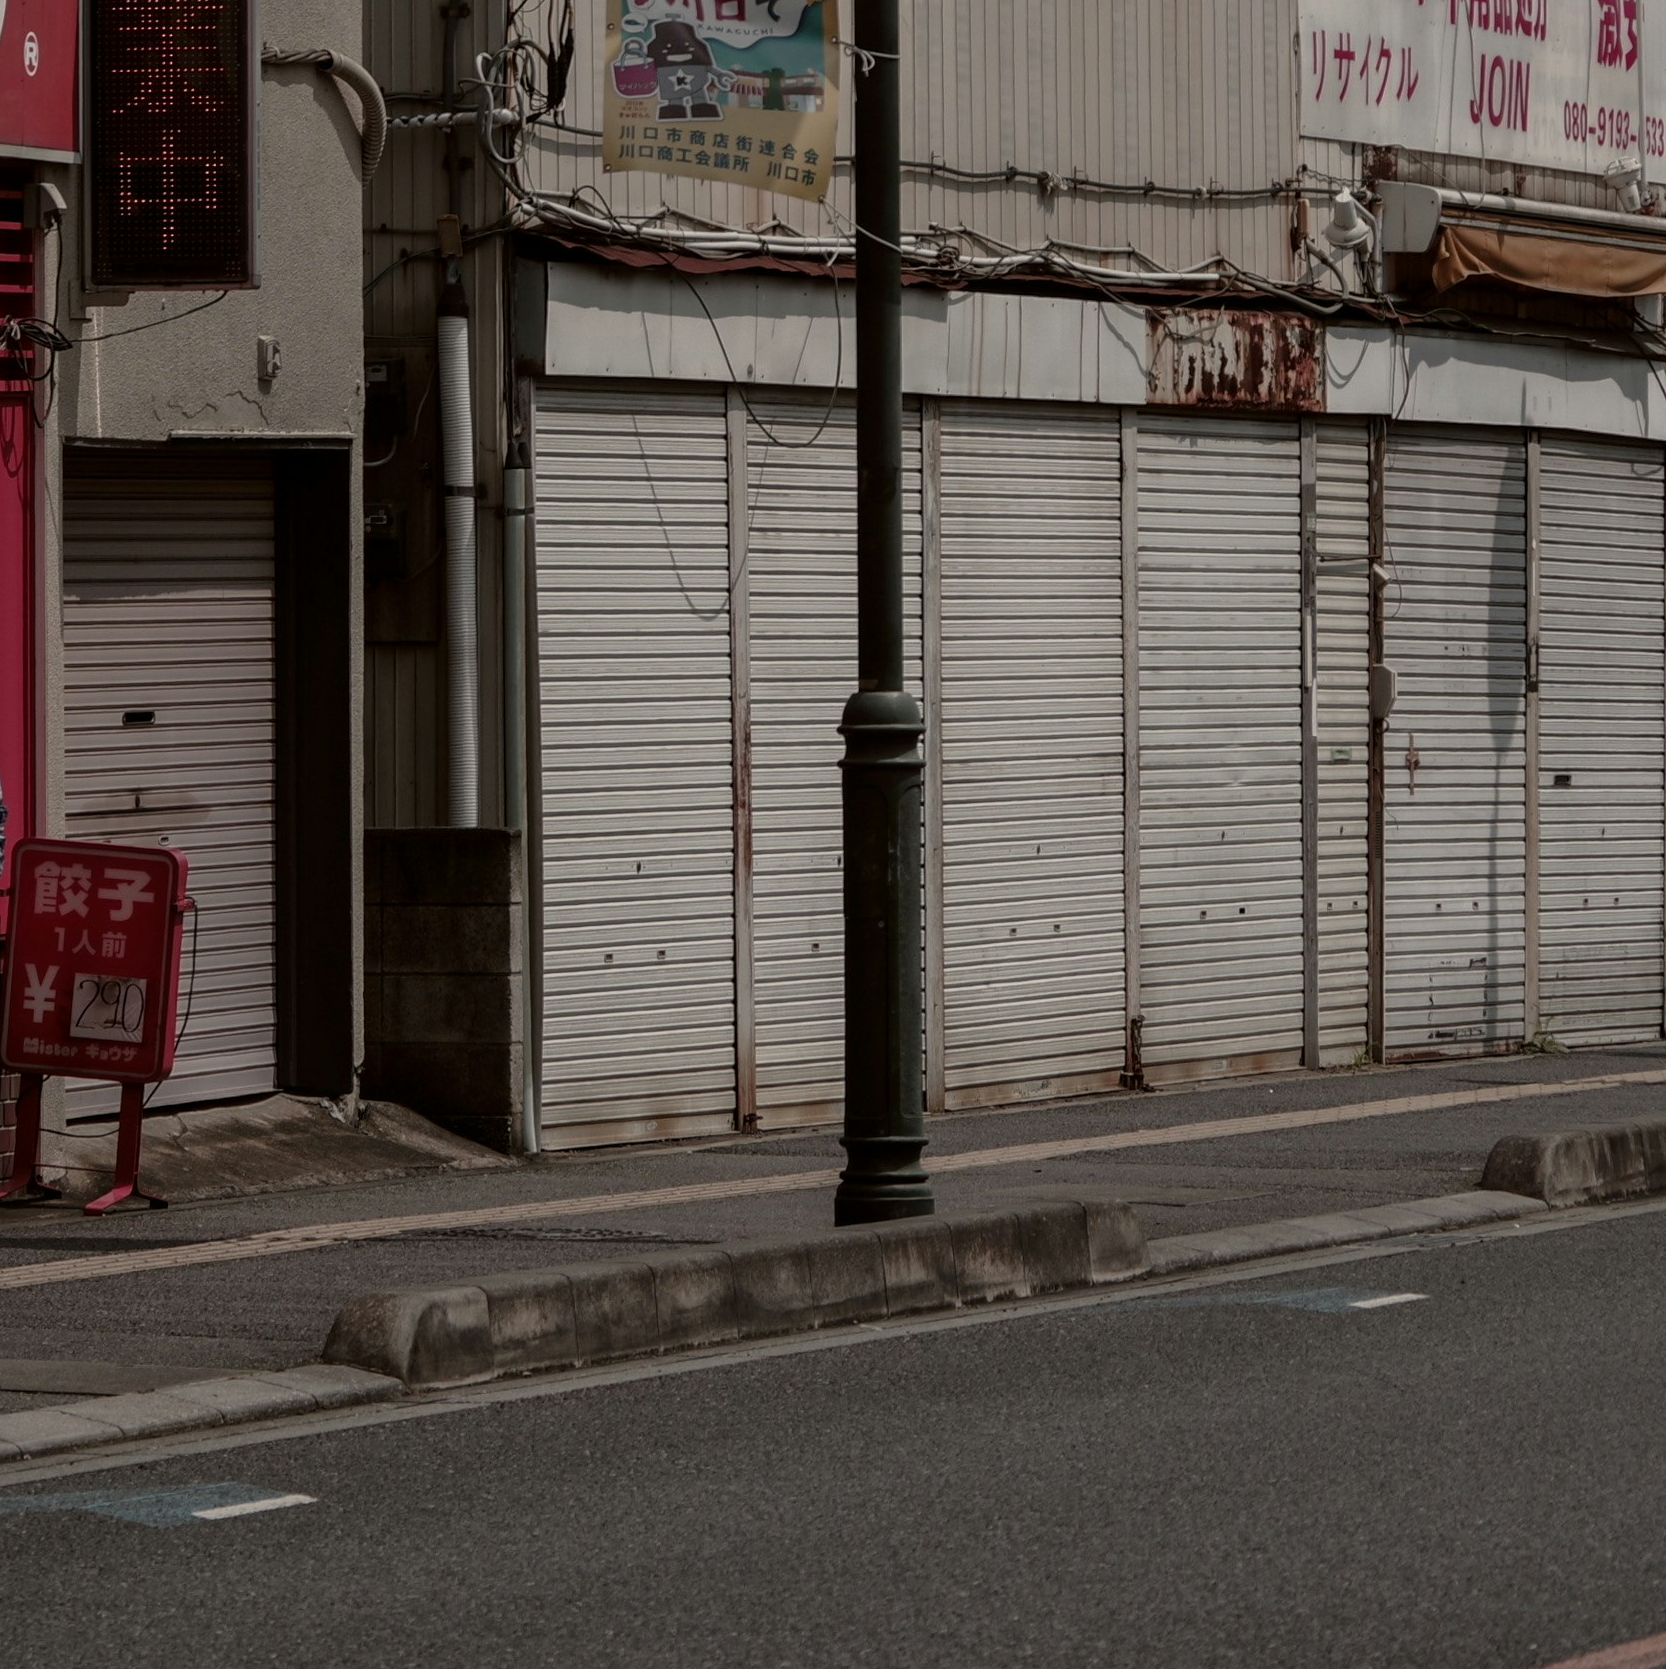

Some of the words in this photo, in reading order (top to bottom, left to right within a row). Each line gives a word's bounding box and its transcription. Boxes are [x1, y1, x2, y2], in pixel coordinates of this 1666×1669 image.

[696, 23, 775, 36] KAWAGUCHI
[1312, 29, 1420, 107] リサイクル
[1470, 54, 1531, 133] JOIN
[1563, 99, 1666, 158] 080-9193-533
[619, 124, 820, 166] 川口市商店街連合会
[619, 143, 751, 173] 川口商工会議所
[766, 160, 818, 187] 川口市
[34, 860, 155, 923] 餃子
[54, 926, 127, 959] 1人前
[77, 977, 145, 1034] 290
[22, 1036, 78, 1059] Mister
